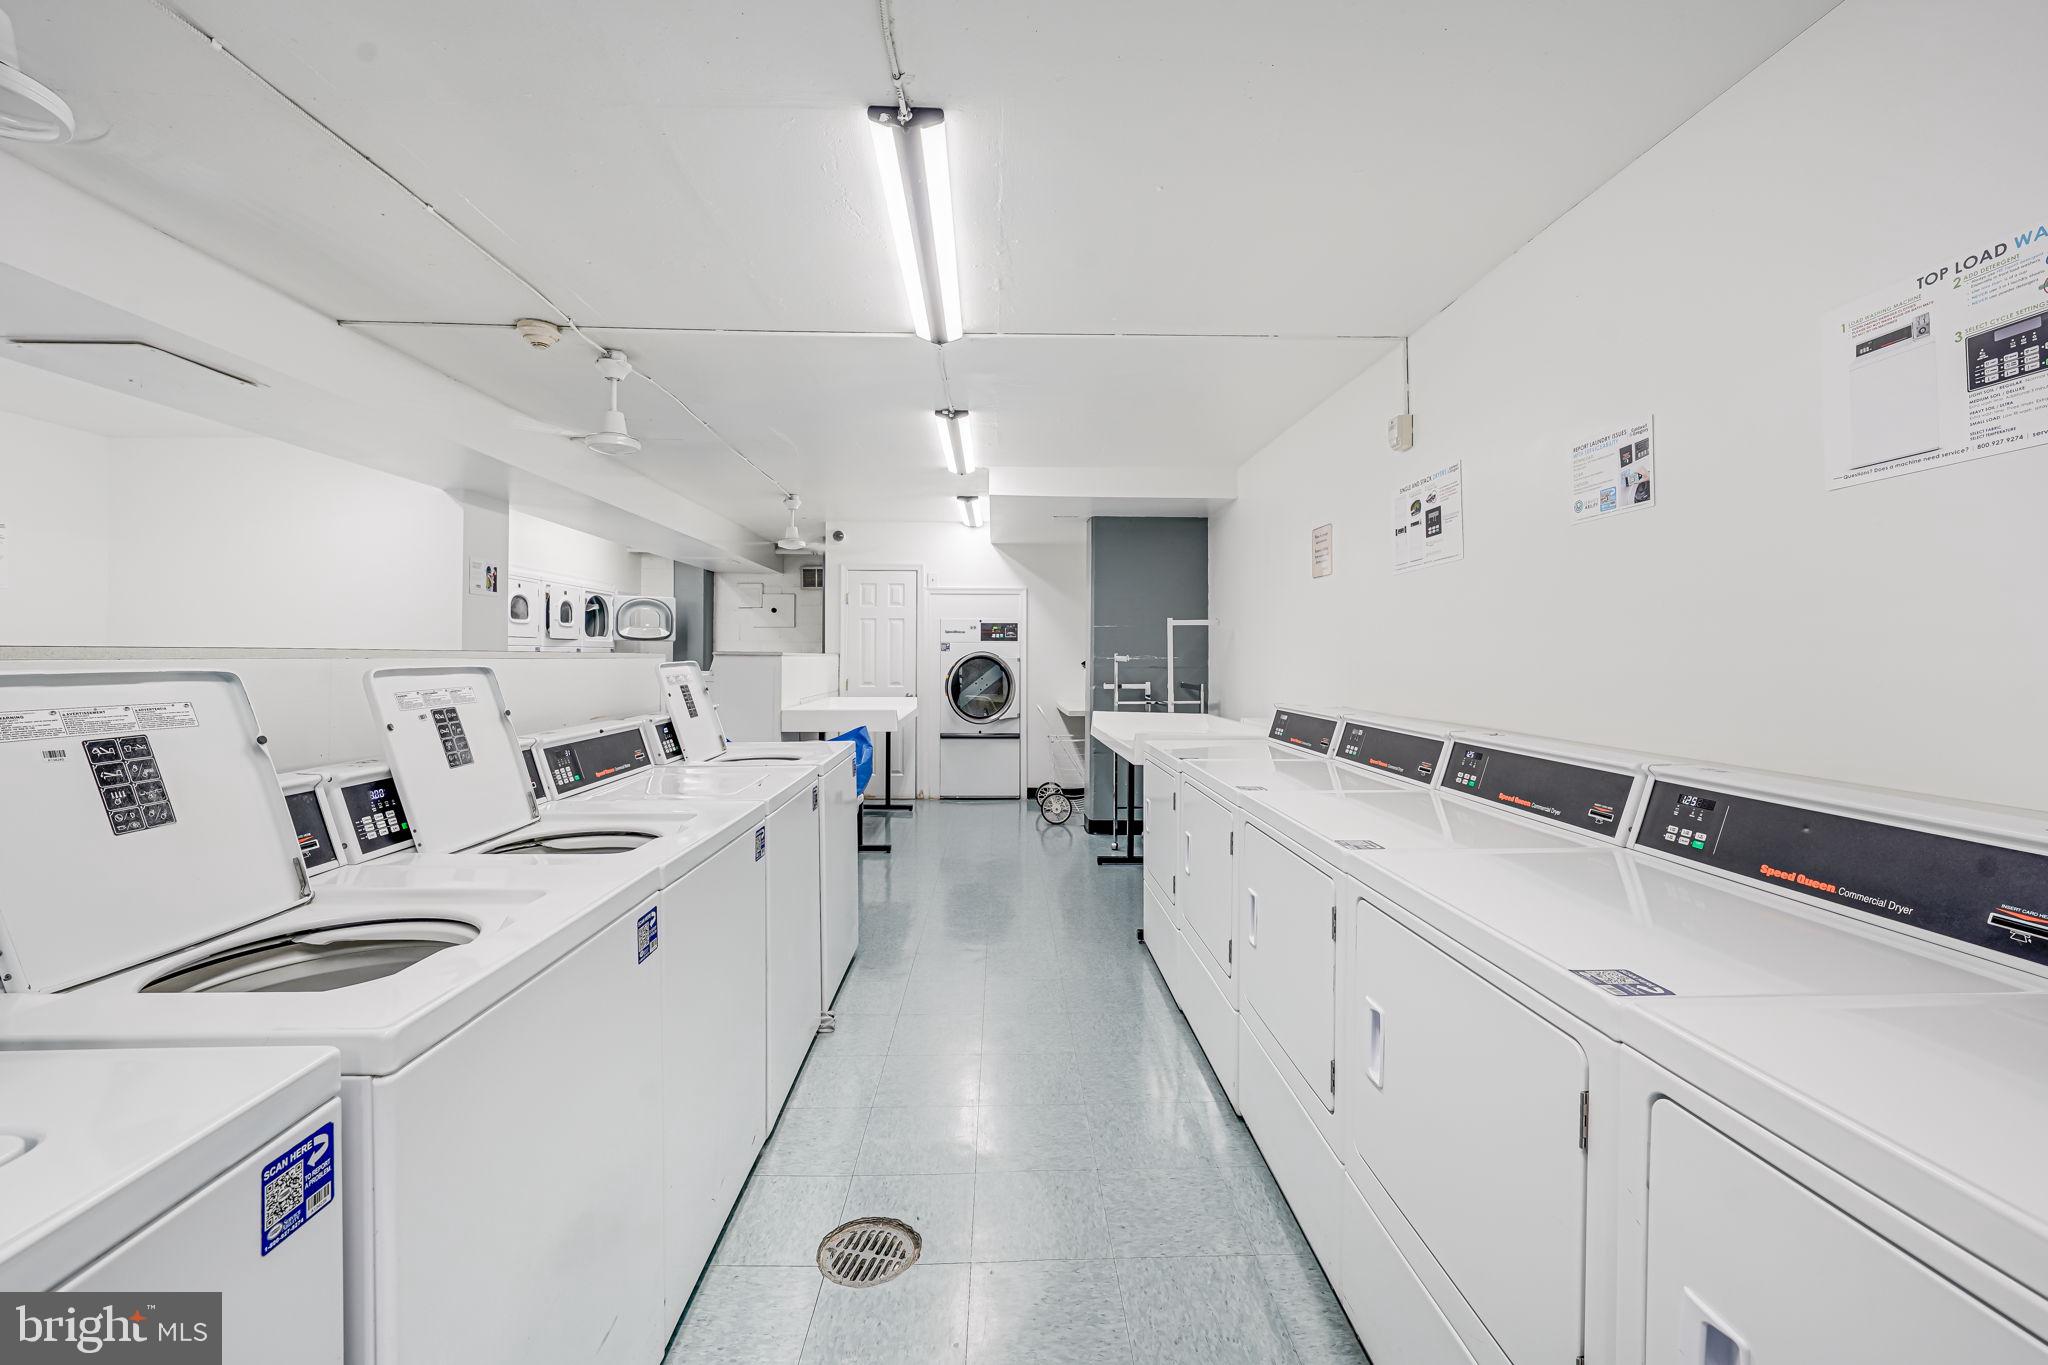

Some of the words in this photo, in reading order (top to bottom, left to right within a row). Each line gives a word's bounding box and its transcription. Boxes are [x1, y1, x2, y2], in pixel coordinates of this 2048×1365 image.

[1917, 266, 1948, 289] TOP
[1955, 242, 2008, 274] LOAD
[1980, 253, 2020, 274] DETERGENT
[1952, 277, 1962, 290] 2
[1893, 293, 1922, 308] MACHINE
[1965, 321, 1988, 333] SELECT
[1990, 312, 2014, 325] CYCLE
[1954, 331, 1963, 343] 3
[1968, 395, 1989, 405] MEDIUM
[2006, 386, 2025, 395] DELUXE
[2000, 380, 2022, 390] REGULAR
[1573, 443, 1589, 453] REPORT
[1590, 435, 1611, 448] LAUNDRY
[1611, 429, 1627, 440] ISSUES
[1986, 426, 2016, 438] TEMPERATURE
[1843, 468, 1872, 480] Questions?
[1874, 465, 1888, 473] Does
[1894, 457, 1922, 468] machine
[1923, 453, 1940, 462] need
[1941, 446, 1970, 459] service?
[1499, 792, 1515, 803] Speed
[1515, 797, 1532, 808] Queen
[1551, 808, 1561, 816] Dryer
[1759, 862, 1796, 882] Speed
[1796, 872, 1837, 894] Queen
[1838, 886, 1888, 908] Commercial
[1888, 901, 1914, 918] Dryer
[2000, 904, 2022, 912] INSERT
[2022, 909, 2038, 917] CARD
[263, 1156, 289, 1182] SCAN
[290, 1139, 314, 1163] HERE
[304, 1172, 312, 1182] TO
[312, 1158, 332, 1178] REPORT
[304, 1182, 308, 1191] A
